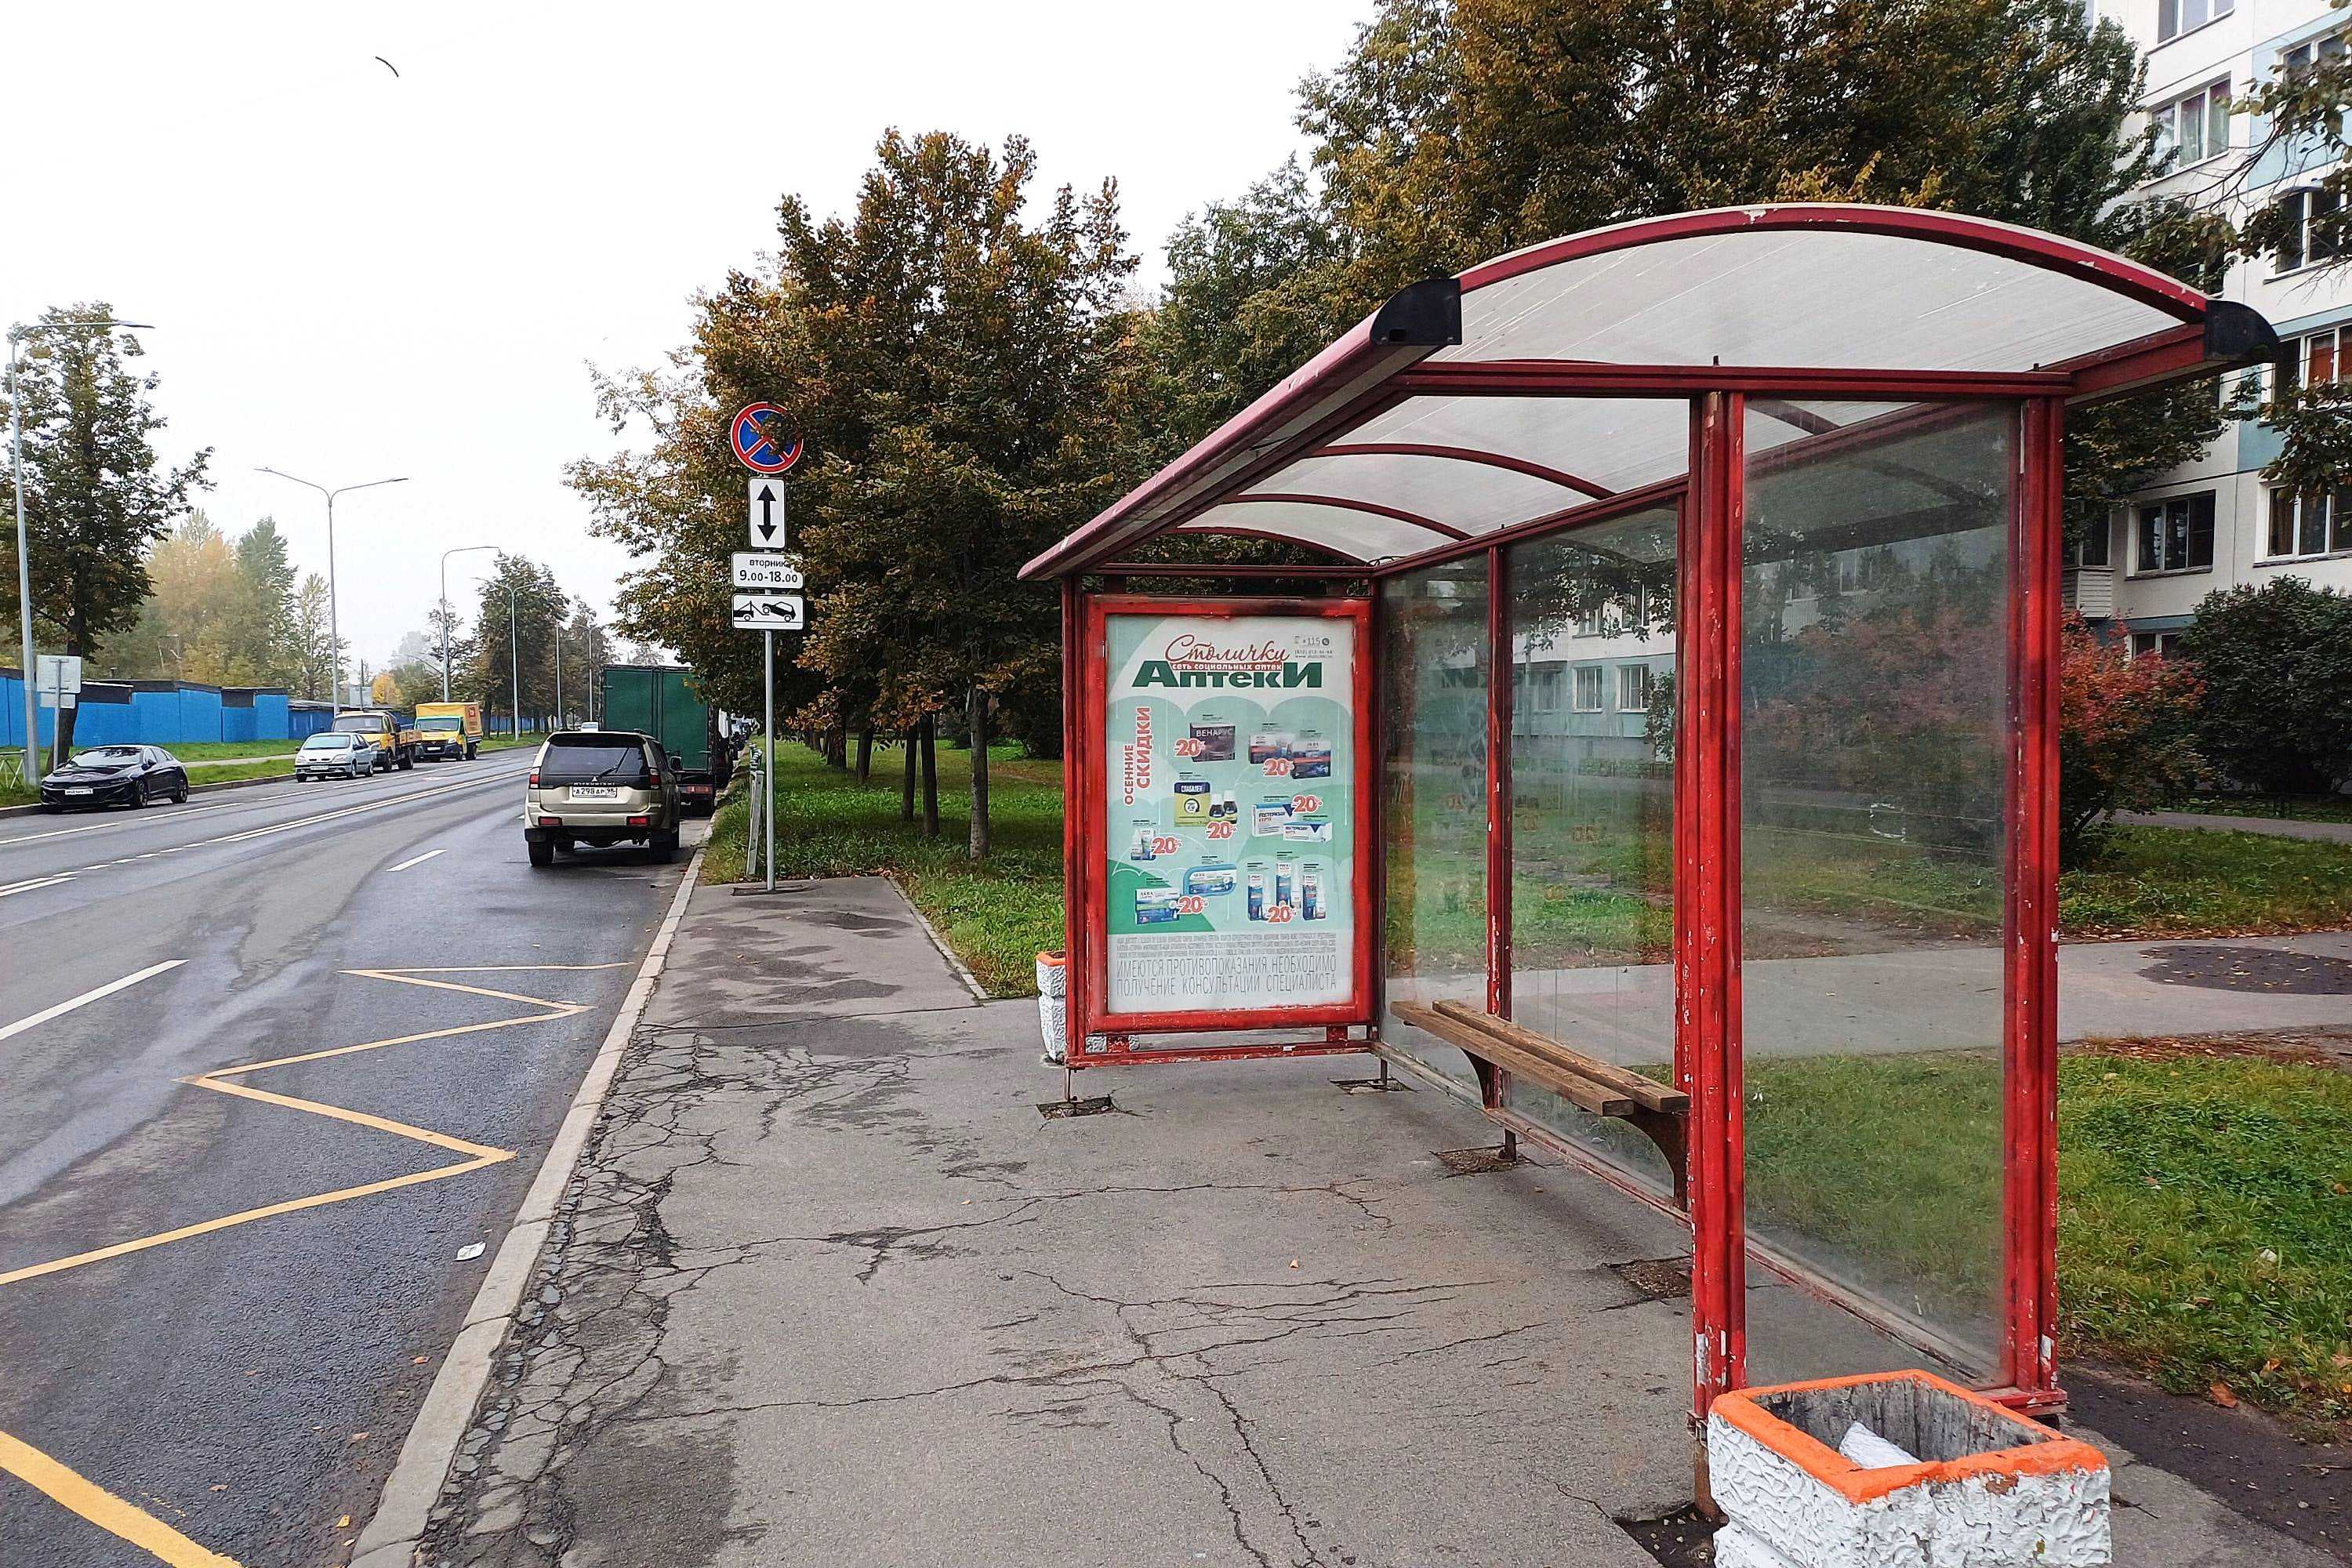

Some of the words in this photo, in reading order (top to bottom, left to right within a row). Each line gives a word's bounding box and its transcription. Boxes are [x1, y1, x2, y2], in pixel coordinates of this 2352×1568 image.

[750, 559, 788, 568] вторник
[739, 569, 798, 583] 9.00-18.00
[1165, 634, 1290, 662] Столички
[1137, 707, 1152, 789] СКИДКИ
[1124, 745, 1134, 805] ОСЕННИЕ
[1117, 959, 1163, 978] ИМЕЮТСЯ
[1272, 954, 1337, 974] НЕОБХОДИМО
[1117, 977, 1176, 996] ПОЛУЧЕНИЕ
[1182, 975, 1261, 996] КОНСУЛЬТАЦИИ
[1266, 973, 1337, 994] СПЕЦИАЛИСТА
